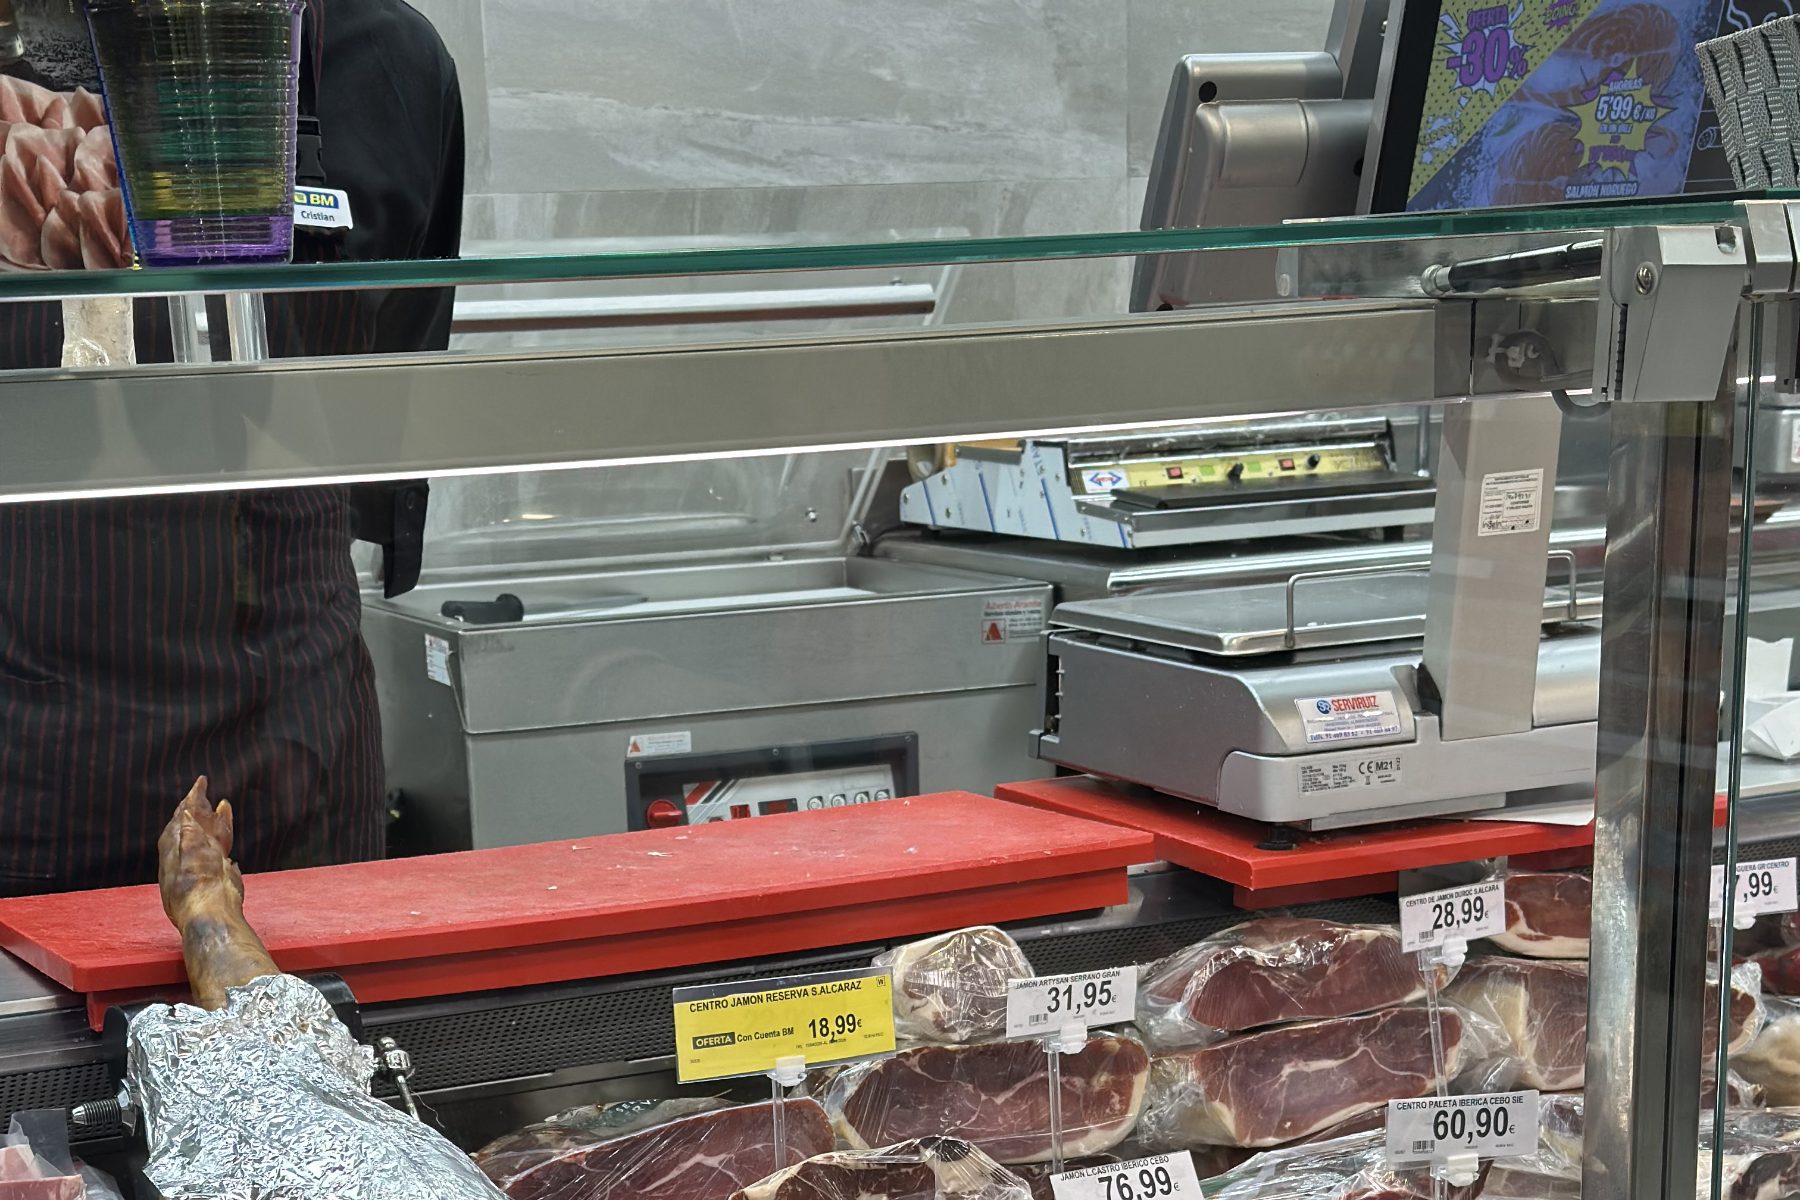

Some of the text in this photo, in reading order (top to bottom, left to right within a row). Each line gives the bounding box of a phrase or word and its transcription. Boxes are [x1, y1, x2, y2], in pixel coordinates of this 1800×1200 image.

[1446, 27, 1528, 86] -30%
[310, 193, 334, 207] BM
[301, 210, 335, 222] Cristian
[1331, 695, 1379, 712] SERVIRUIZ
[1376, 761, 1393, 771] M21
[1767, 861, 1789, 869] CENTRO
[1406, 898, 1427, 907] CENTRO
[1436, 893, 1453, 902] JAMON
[1016, 981, 1038, 990] JAMON
[1039, 977, 1068, 986] ARTYSAN
[1070, 972, 1100, 982] SERRANO
[690, 981, 862, 1013] CENTRO JAMON RESERVA S.ALCARAZ
[695, 1027, 794, 1048] OFERTA Con Cuenta BM
[1397, 1101, 1427, 1110] CENTRO
[1428, 1099, 1457, 1109] PALETA
[1459, 1097, 1488, 1107] IBERICA
[1490, 1096, 1510, 1105] CEBO
[1060, 1155, 1169, 1181] JAMON L.CASTRO IBERICO CEBO
